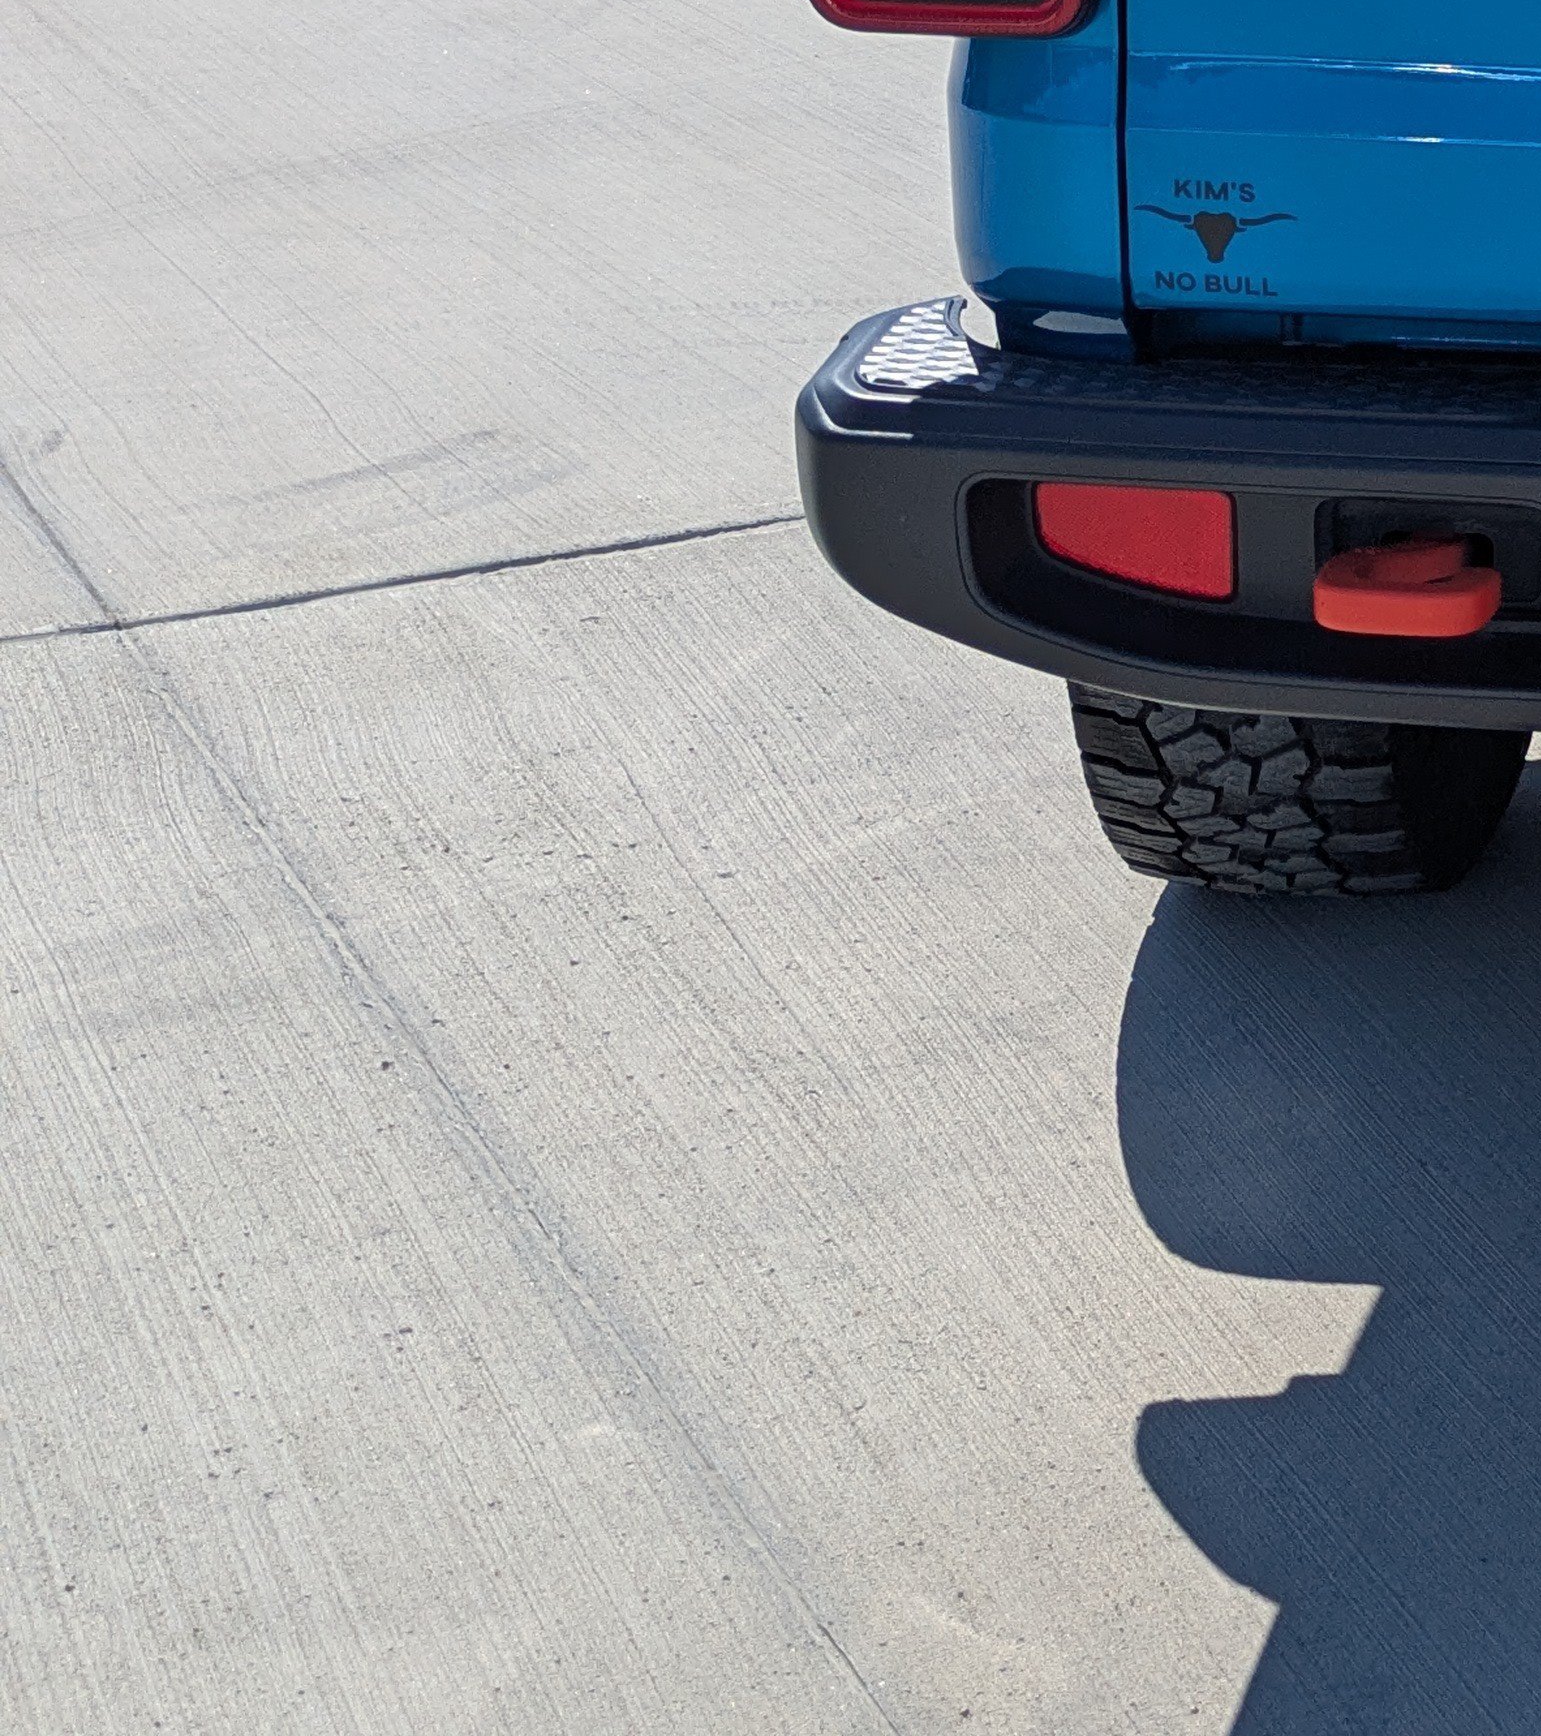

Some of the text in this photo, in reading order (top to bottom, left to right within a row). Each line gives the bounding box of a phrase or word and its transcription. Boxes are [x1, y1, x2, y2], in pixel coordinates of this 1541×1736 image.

[1172, 178, 1256, 203] KIM'S
[1154, 270, 1279, 297] NO BULL
